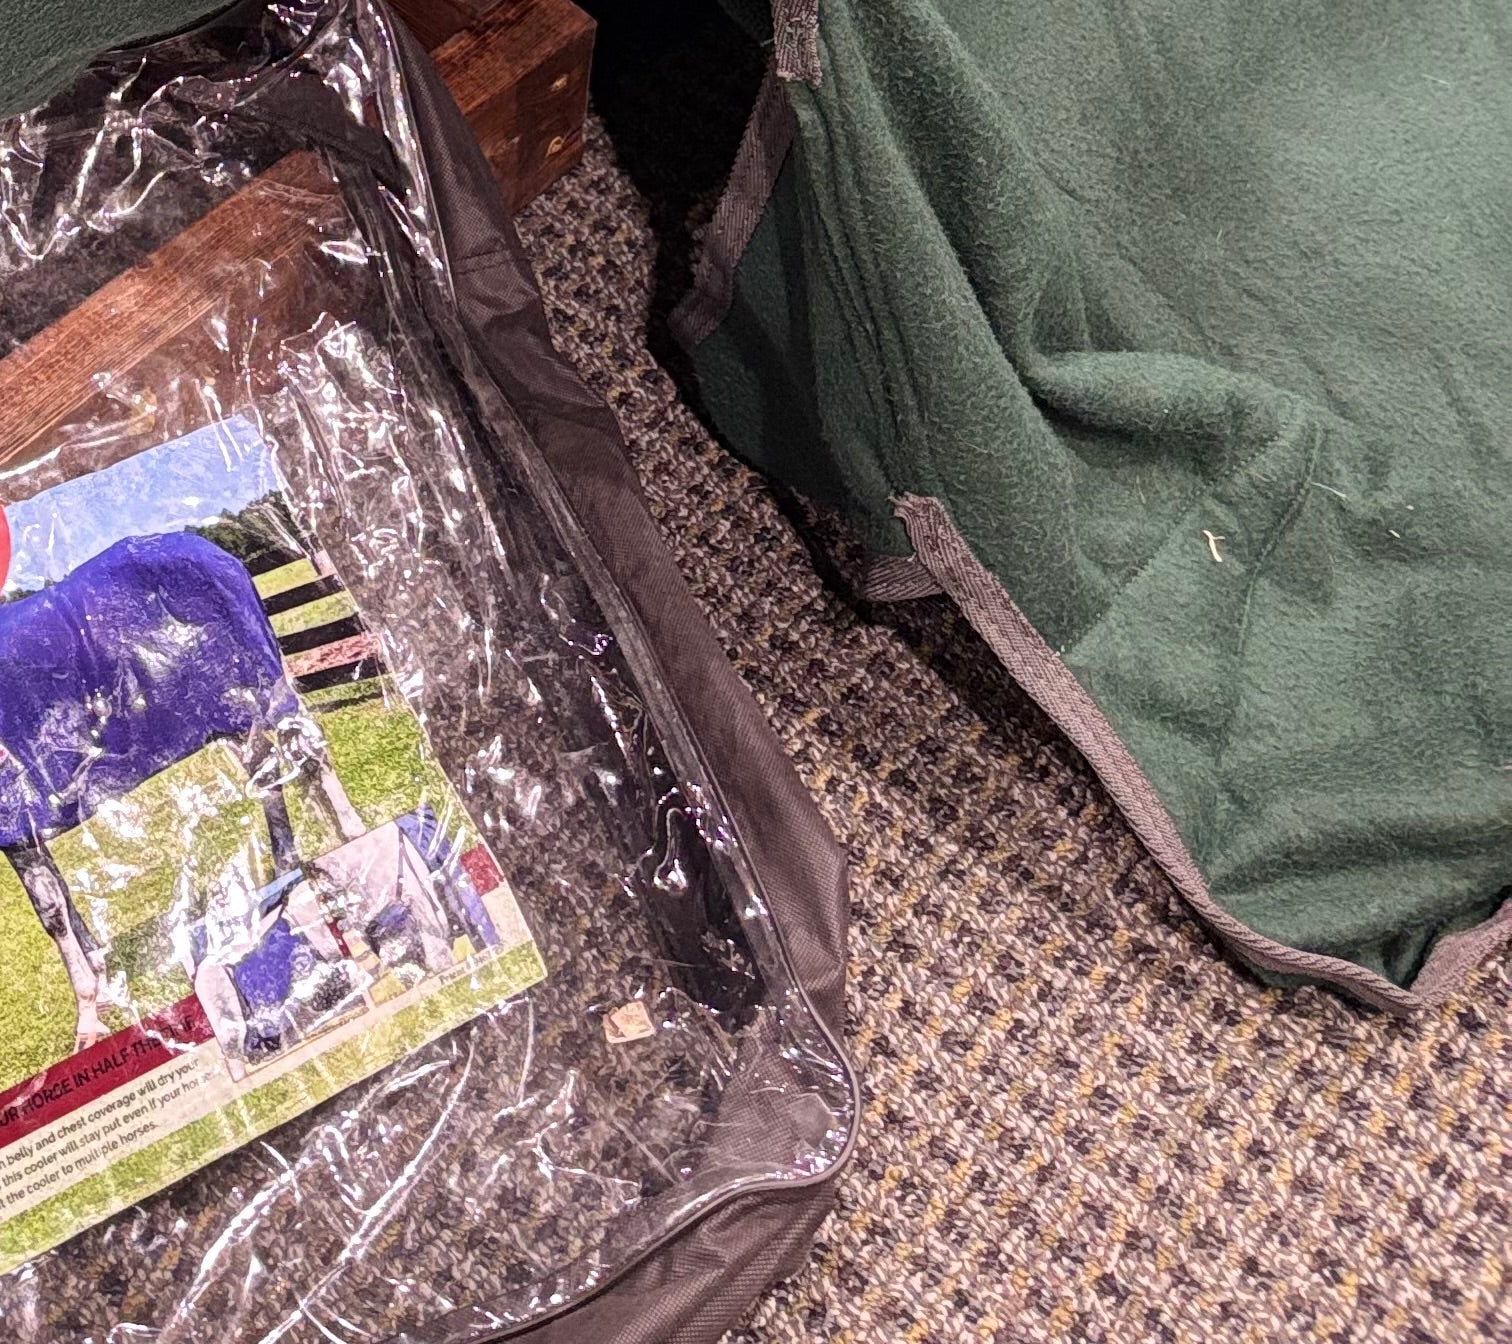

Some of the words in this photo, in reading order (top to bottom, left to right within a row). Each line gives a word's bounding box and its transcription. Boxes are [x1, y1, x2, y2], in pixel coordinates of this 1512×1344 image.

[4, 1142, 36, 1167] belly
[32, 1131, 56, 1150] and
[55, 1116, 87, 1139] chest
[86, 1091, 138, 1125] coverage
[135, 1078, 157, 1096] will
[155, 1069, 177, 1088] dry
[174, 1058, 202, 1079] your
[18, 1077, 73, 1115] HORSE
[71, 1068, 92, 1087] IN
[89, 1046, 132, 1077] HALF
[130, 1032, 161, 1057] THE
[0, 1168, 23, 1187] this
[21, 1149, 60, 1176] cooler
[57, 1140, 78, 1157] will
[76, 1127, 103, 1149] stay
[100, 1116, 123, 1136] put
[121, 1104, 149, 1124] even
[147, 1097, 158, 1110] if
[156, 1086, 183, 1107] your
[4, 1187, 26, 1204] the
[24, 1168, 62, 1194] cooler
[60, 1162, 74, 1175] to
